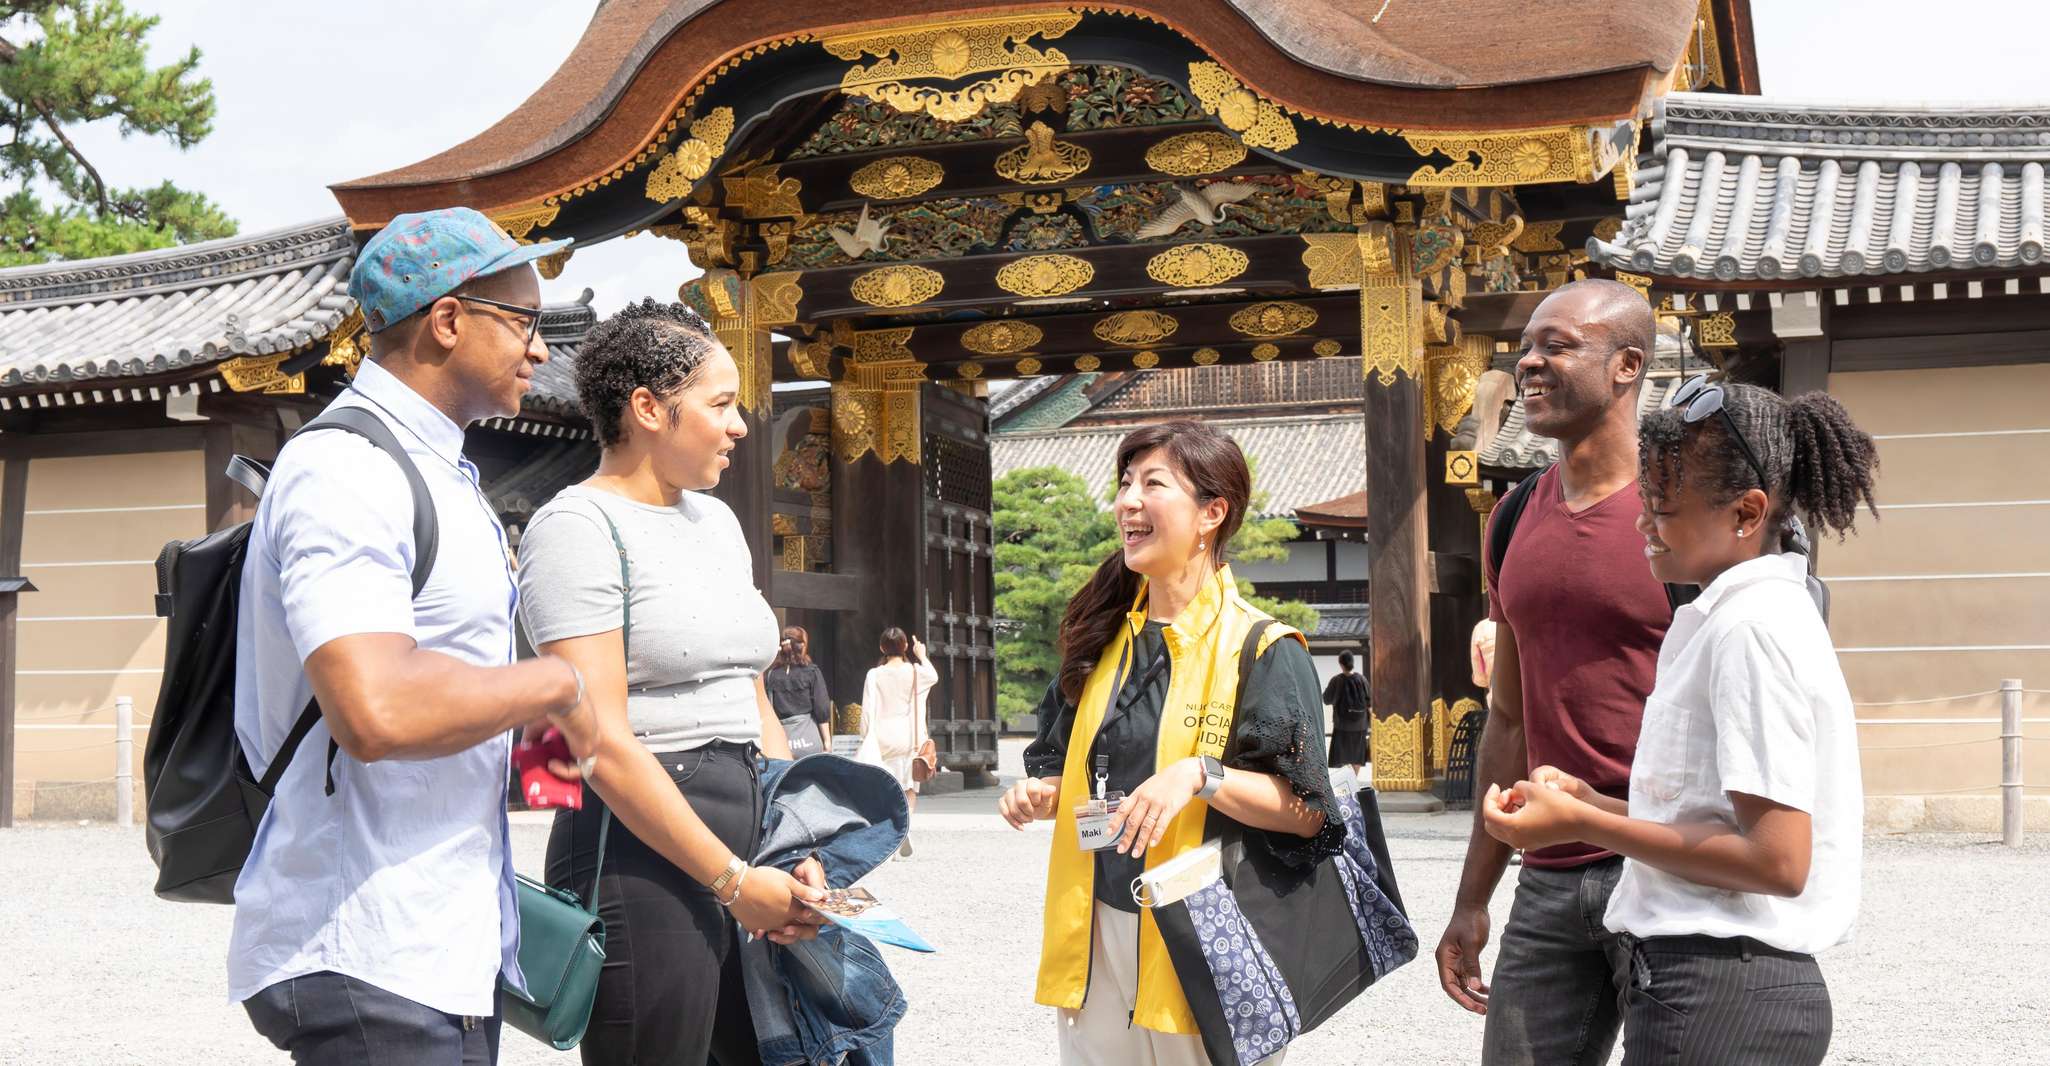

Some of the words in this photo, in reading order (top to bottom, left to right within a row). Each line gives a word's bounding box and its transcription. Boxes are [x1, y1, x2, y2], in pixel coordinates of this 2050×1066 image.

[1210, 701, 1232, 711] CAS
[1184, 714, 1230, 728] OFCIA
[1196, 731, 1226, 748] IDE
[1081, 828, 1102, 838] Maki
